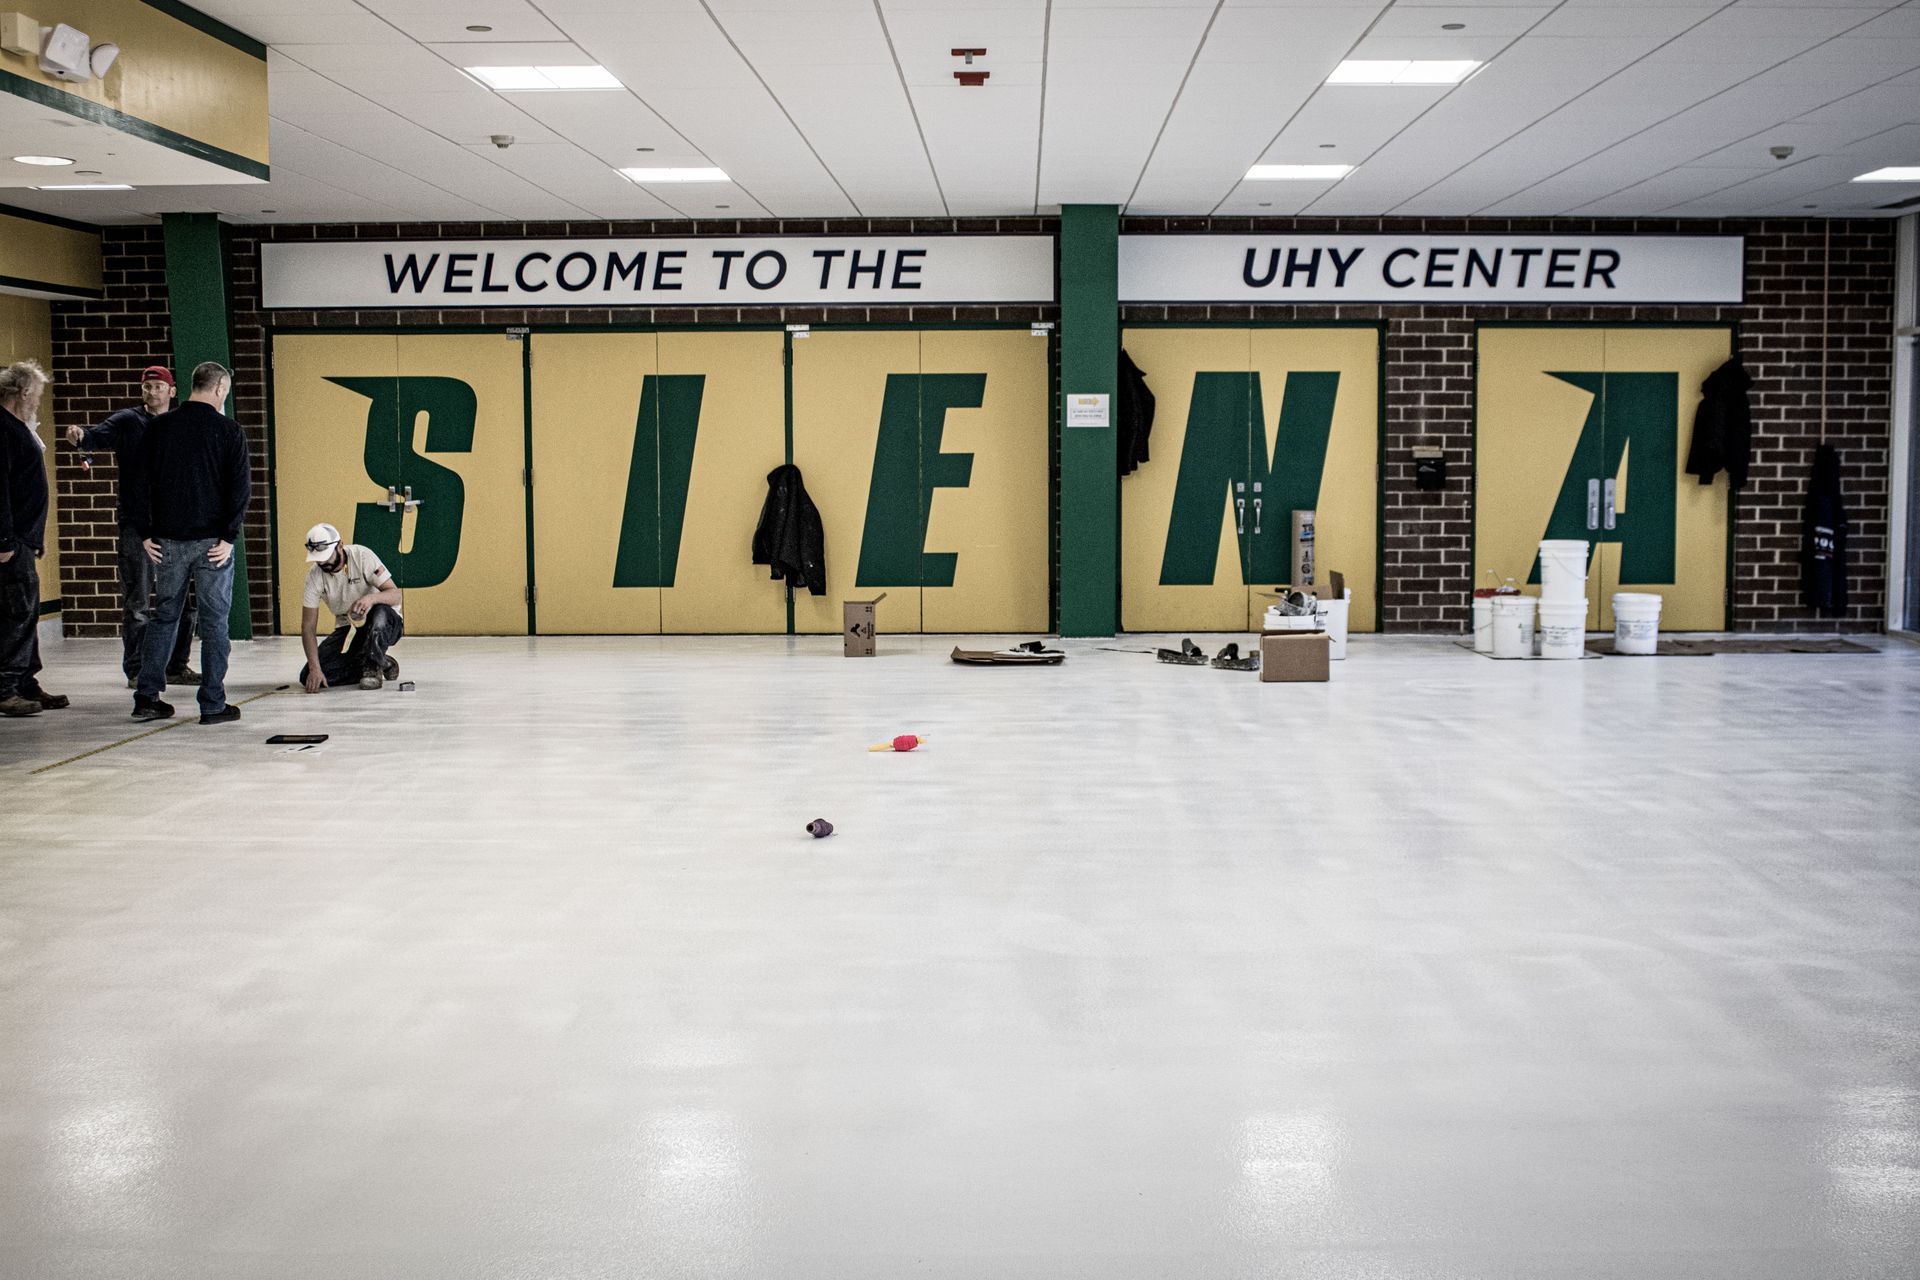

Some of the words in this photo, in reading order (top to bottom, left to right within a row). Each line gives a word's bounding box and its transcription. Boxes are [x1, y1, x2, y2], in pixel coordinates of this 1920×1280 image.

[383, 251, 688, 294] WELCOME
[711, 249, 788, 291] TO
[812, 249, 927, 290] THE
[1242, 247, 1365, 288] UHY
[1382, 247, 1621, 289] CENTER
[320, 371, 1679, 588] SIENA
